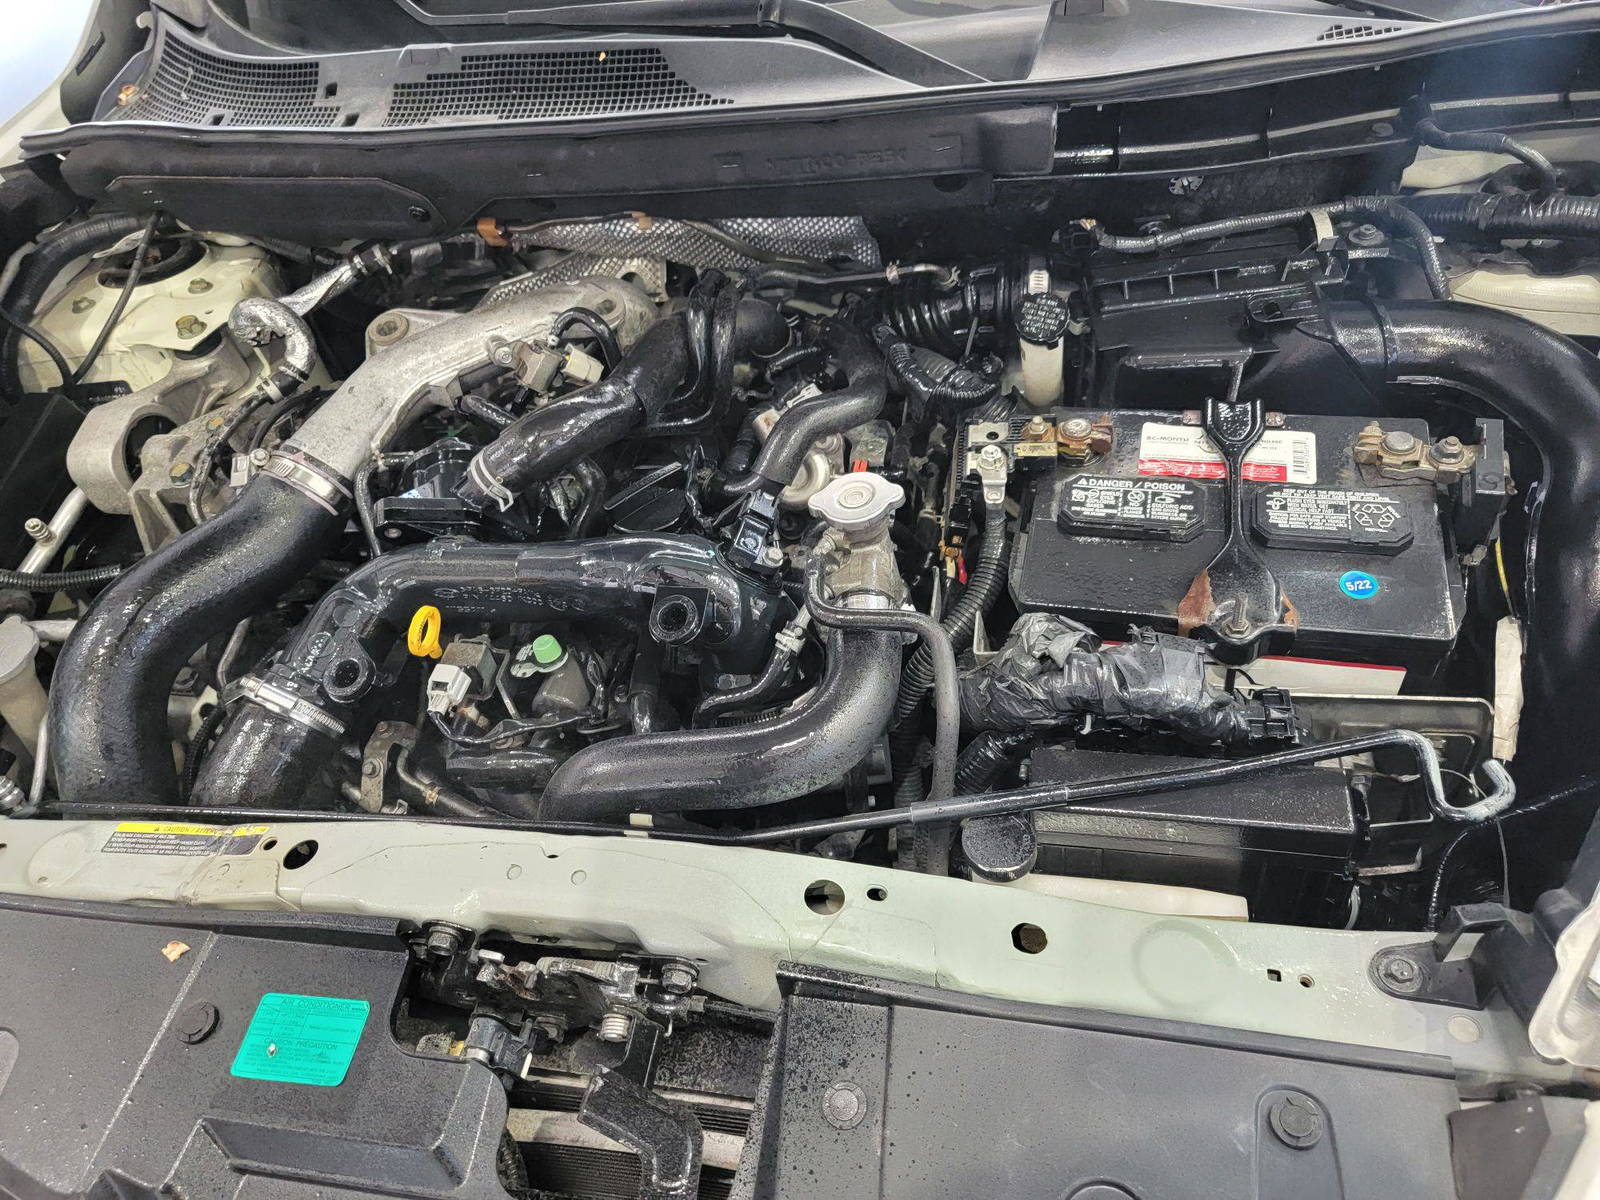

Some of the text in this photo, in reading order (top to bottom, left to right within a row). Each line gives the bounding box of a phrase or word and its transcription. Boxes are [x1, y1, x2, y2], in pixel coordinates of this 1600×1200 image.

[1089, 479, 1133, 488] DANGER
[1144, 482, 1186, 490] POISON
[1345, 579, 1373, 591] 5/22
[163, 825, 190, 833] CAUTION
[281, 999, 352, 1010] AIR CONDITIONER
[296, 1040, 338, 1050] PRECAUTION
